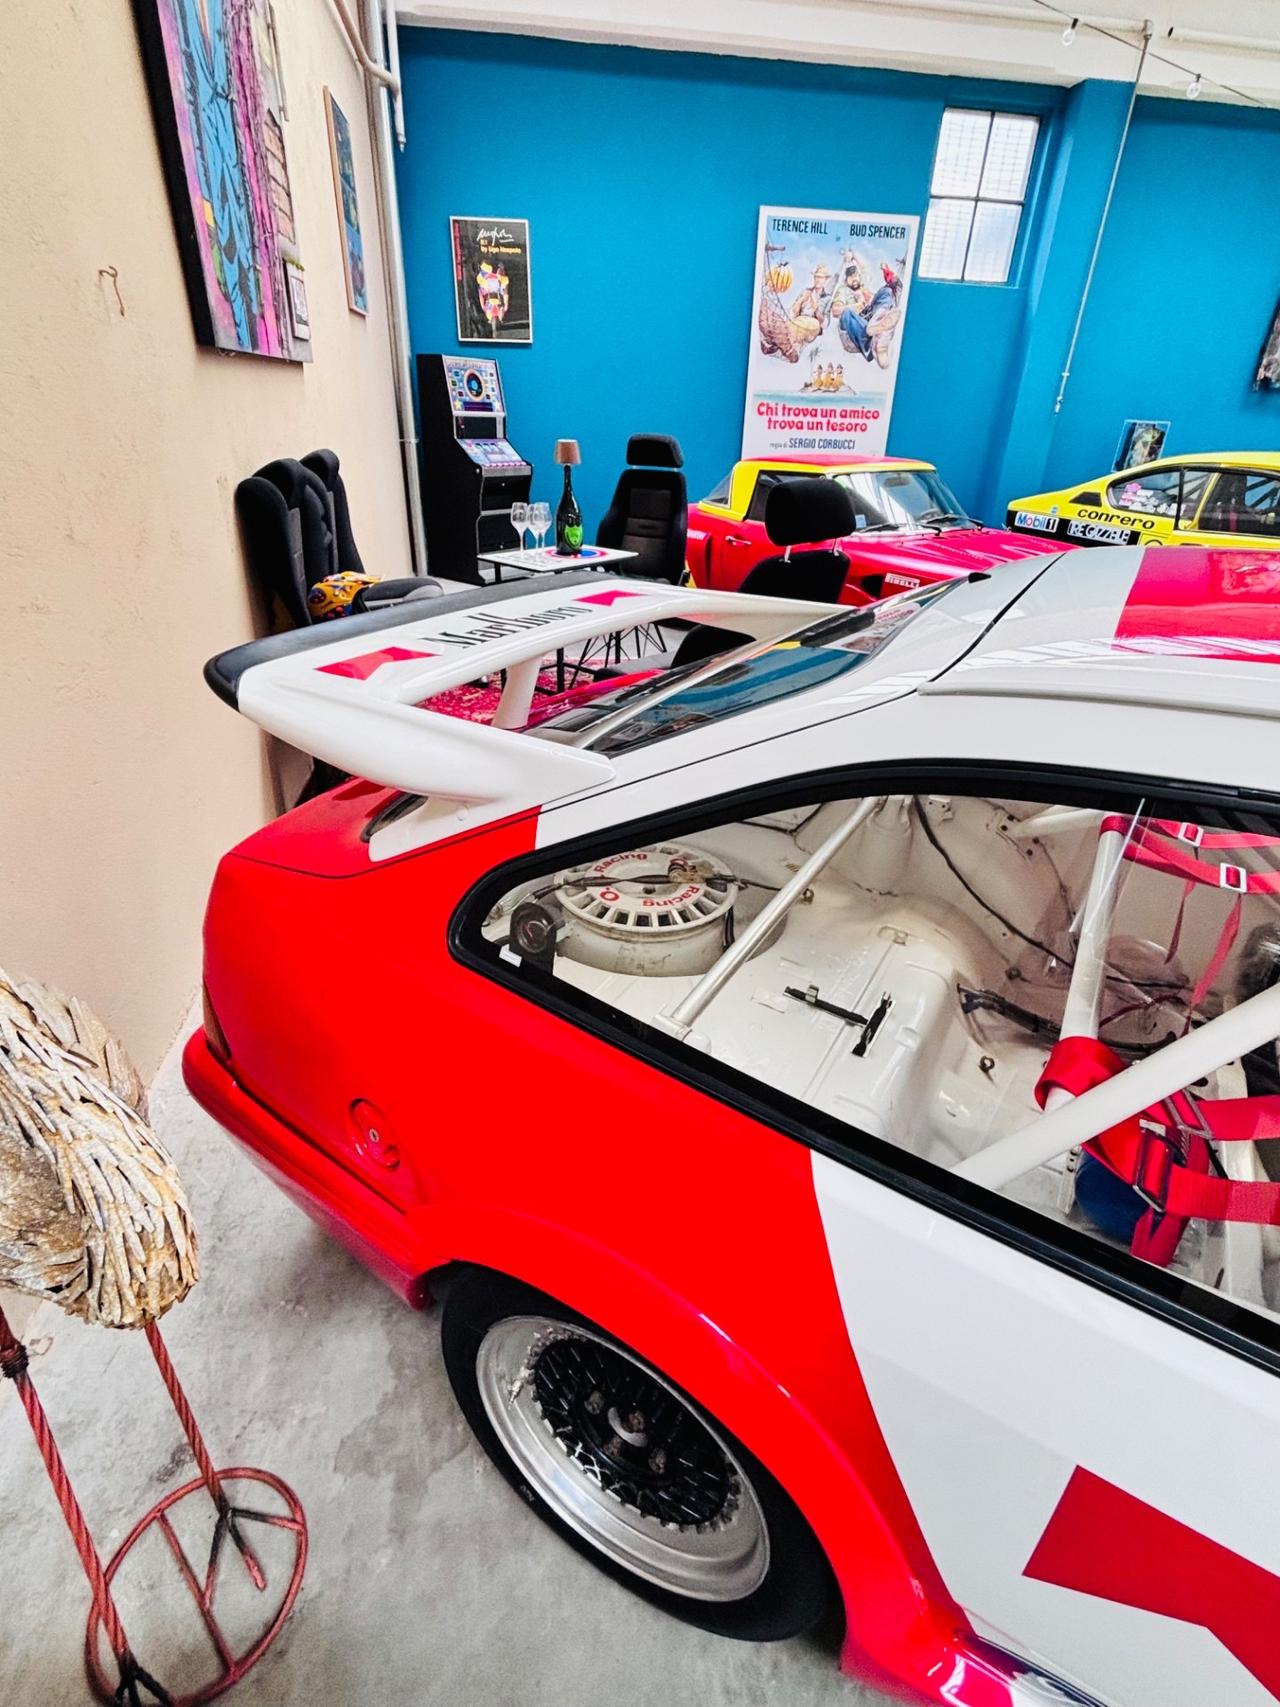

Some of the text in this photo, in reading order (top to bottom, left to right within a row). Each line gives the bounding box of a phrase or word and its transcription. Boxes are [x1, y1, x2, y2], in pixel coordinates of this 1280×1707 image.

[772, 219, 828, 235] TERENCE HILL
[850, 224, 906, 240] BUD SPENCER
[757, 402, 880, 420] Chi trova un amico
[767, 417, 868, 433] trova un tesoro
[789, 437, 817, 449] SERGIO
[817, 438, 856, 450] CORBUCCI
[1016, 513, 1047, 529] Mobil
[1077, 508, 1155, 530] conrero
[885, 572, 921, 590] PIRELLI
[417, 605, 593, 649] Marlboro
[593, 852, 648, 874] Racing
[642, 884, 700, 907] Racing
